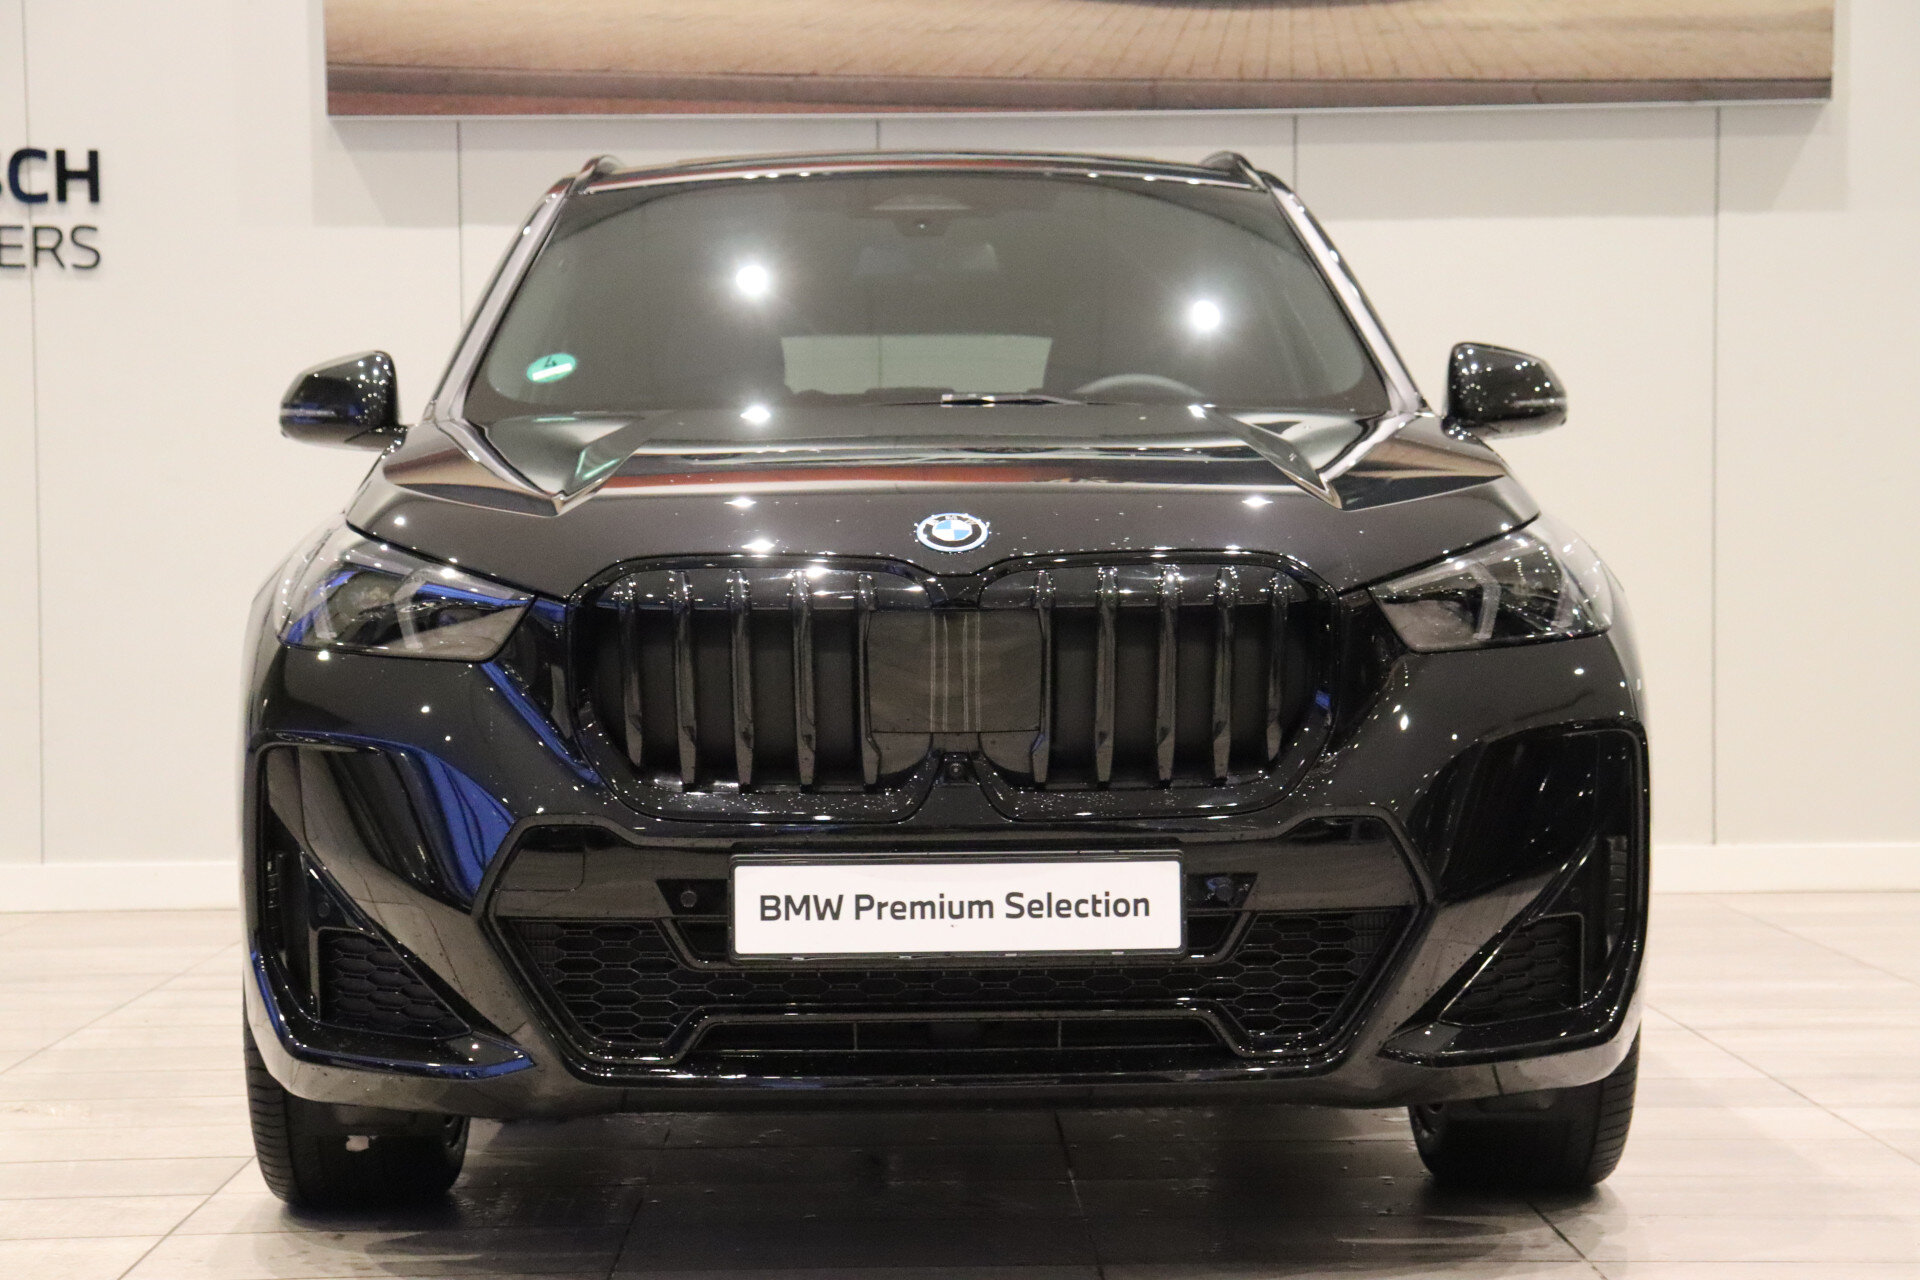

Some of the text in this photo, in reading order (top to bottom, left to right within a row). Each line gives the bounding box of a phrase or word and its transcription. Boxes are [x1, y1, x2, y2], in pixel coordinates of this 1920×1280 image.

[0, 148, 100, 203] CH
[0, 224, 101, 269] ERS
[759, 891, 1150, 921] BMW Premium Selection
